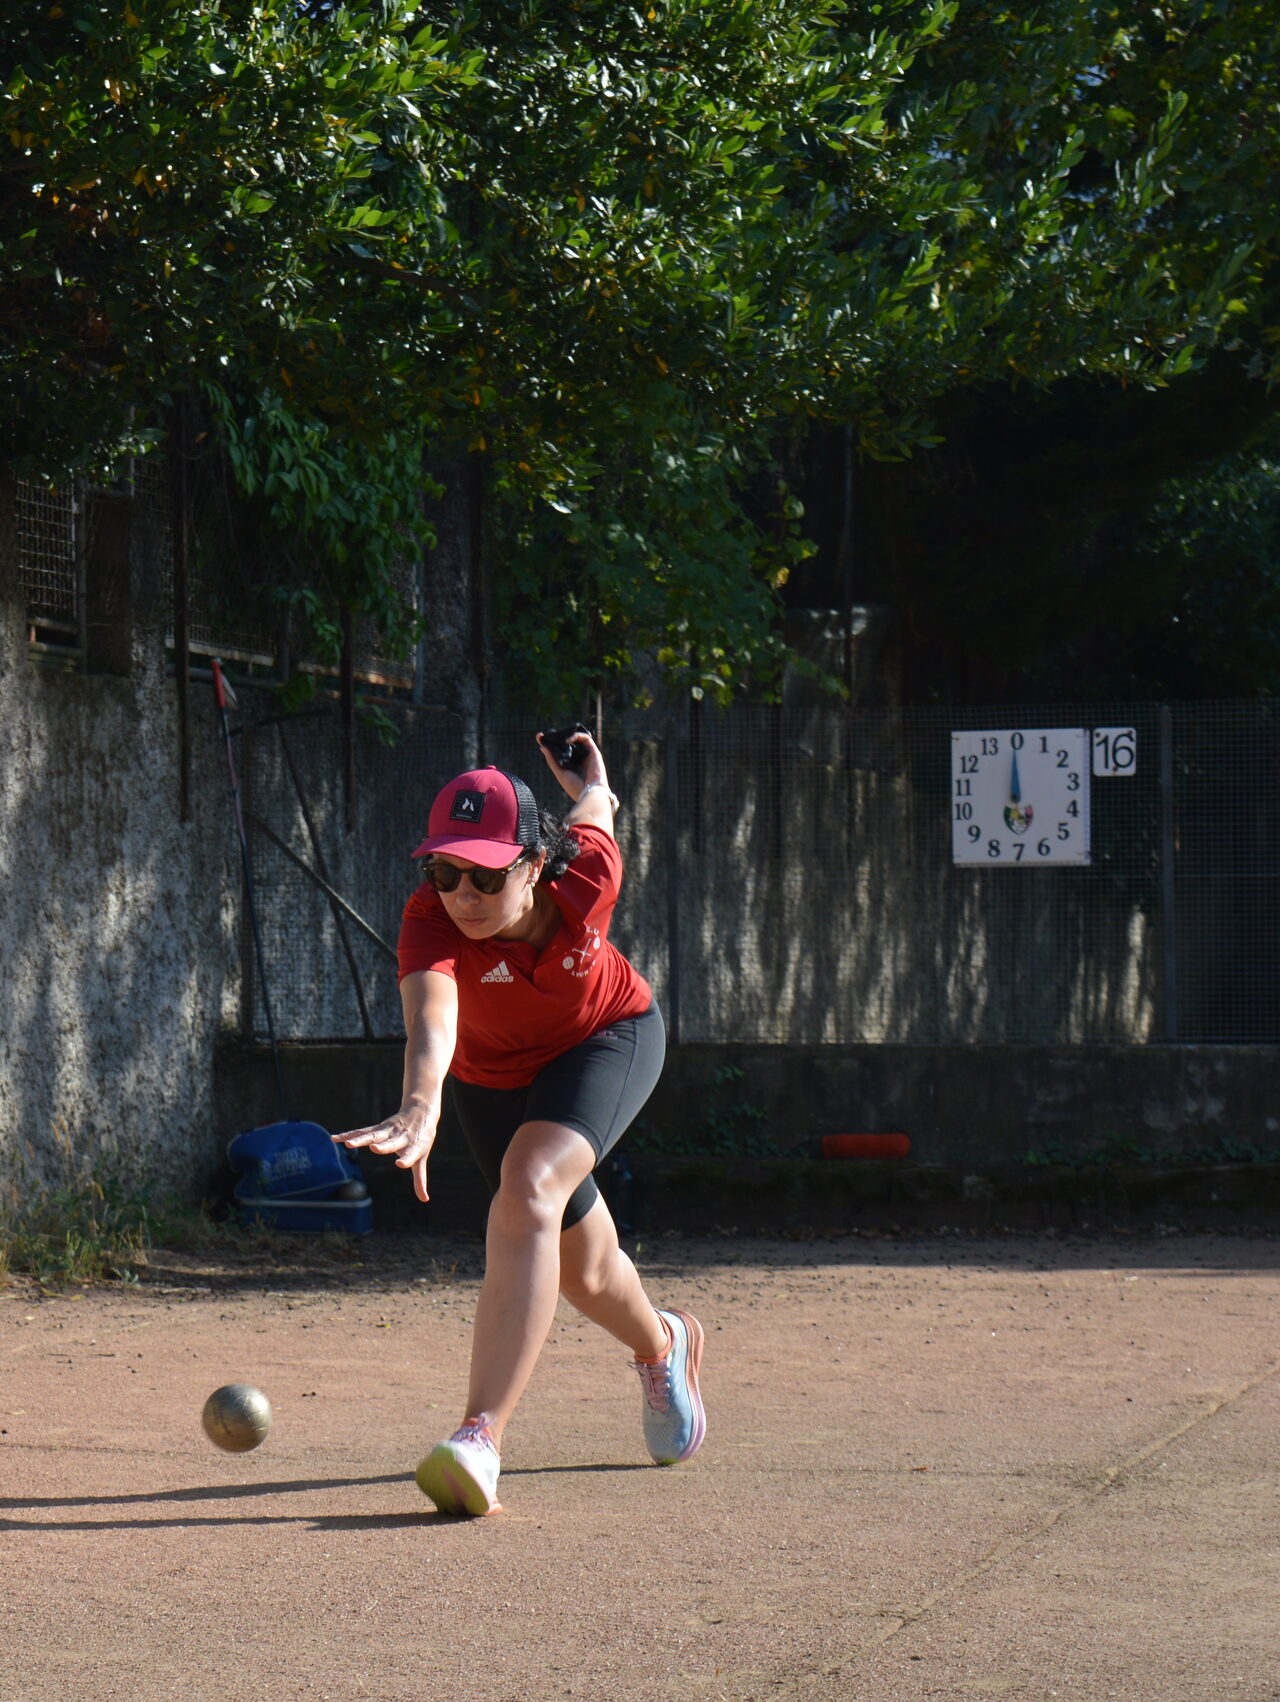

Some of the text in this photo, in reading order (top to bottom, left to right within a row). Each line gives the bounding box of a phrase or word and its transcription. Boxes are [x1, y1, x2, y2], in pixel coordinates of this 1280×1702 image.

[981, 737, 999, 755] 13
[1011, 732, 1024, 750] 0
[1039, 736, 1049, 753] 1
[1056, 750, 1069, 768] 2
[1095, 733, 1134, 770] 16
[960, 755, 979, 773] 12
[955, 779, 971, 796] 11
[1067, 773, 1080, 791] 3
[955, 802, 973, 820] 10
[1066, 800, 1079, 818] 4
[968, 825, 981, 843] 9
[1057, 822, 1070, 840] 5
[988, 839, 1001, 857] 8
[1012, 843, 1025, 861] 7
[1037, 838, 1050, 856] 6
[480, 975, 514, 984] adidas
